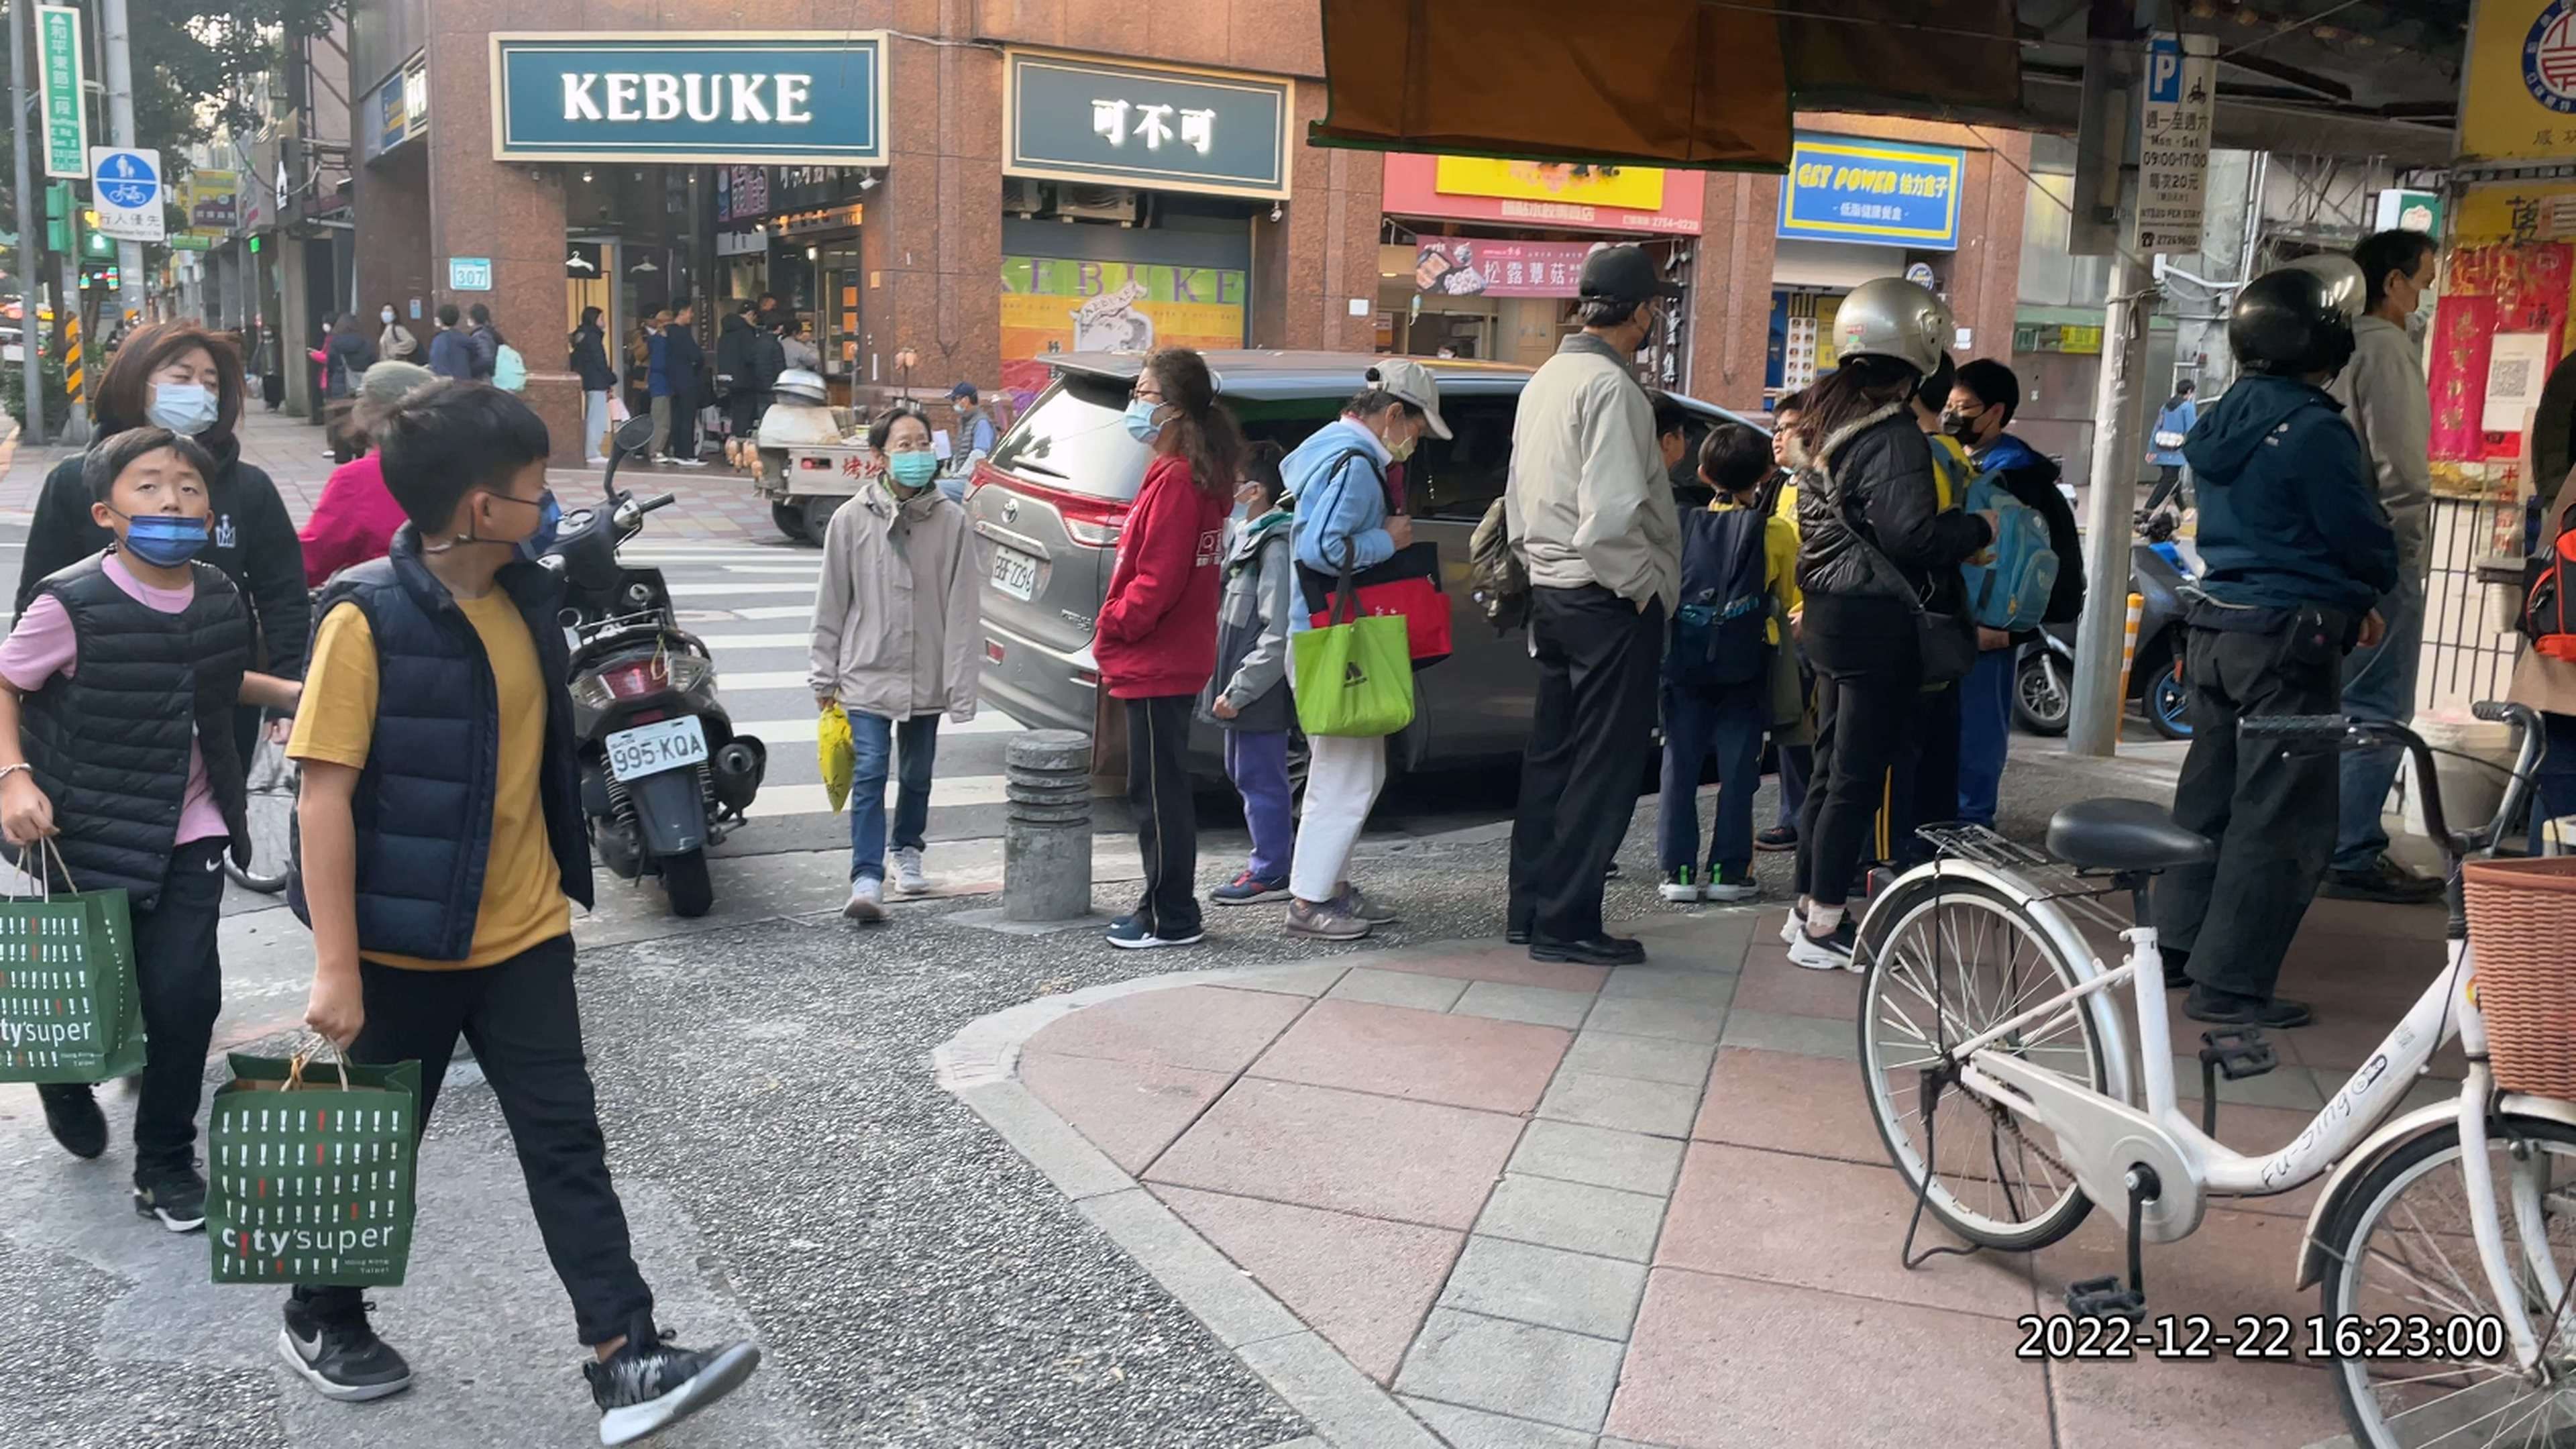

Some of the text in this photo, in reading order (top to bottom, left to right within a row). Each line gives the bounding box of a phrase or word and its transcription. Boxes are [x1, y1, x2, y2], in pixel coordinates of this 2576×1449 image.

[2153, 55, 2176, 94] P
[561, 73, 812, 123] KEBUKE
[1091, 99, 1217, 154] 可不可
[458, 270, 484, 284] 307
[614, 733, 703, 771] 995-KQA
